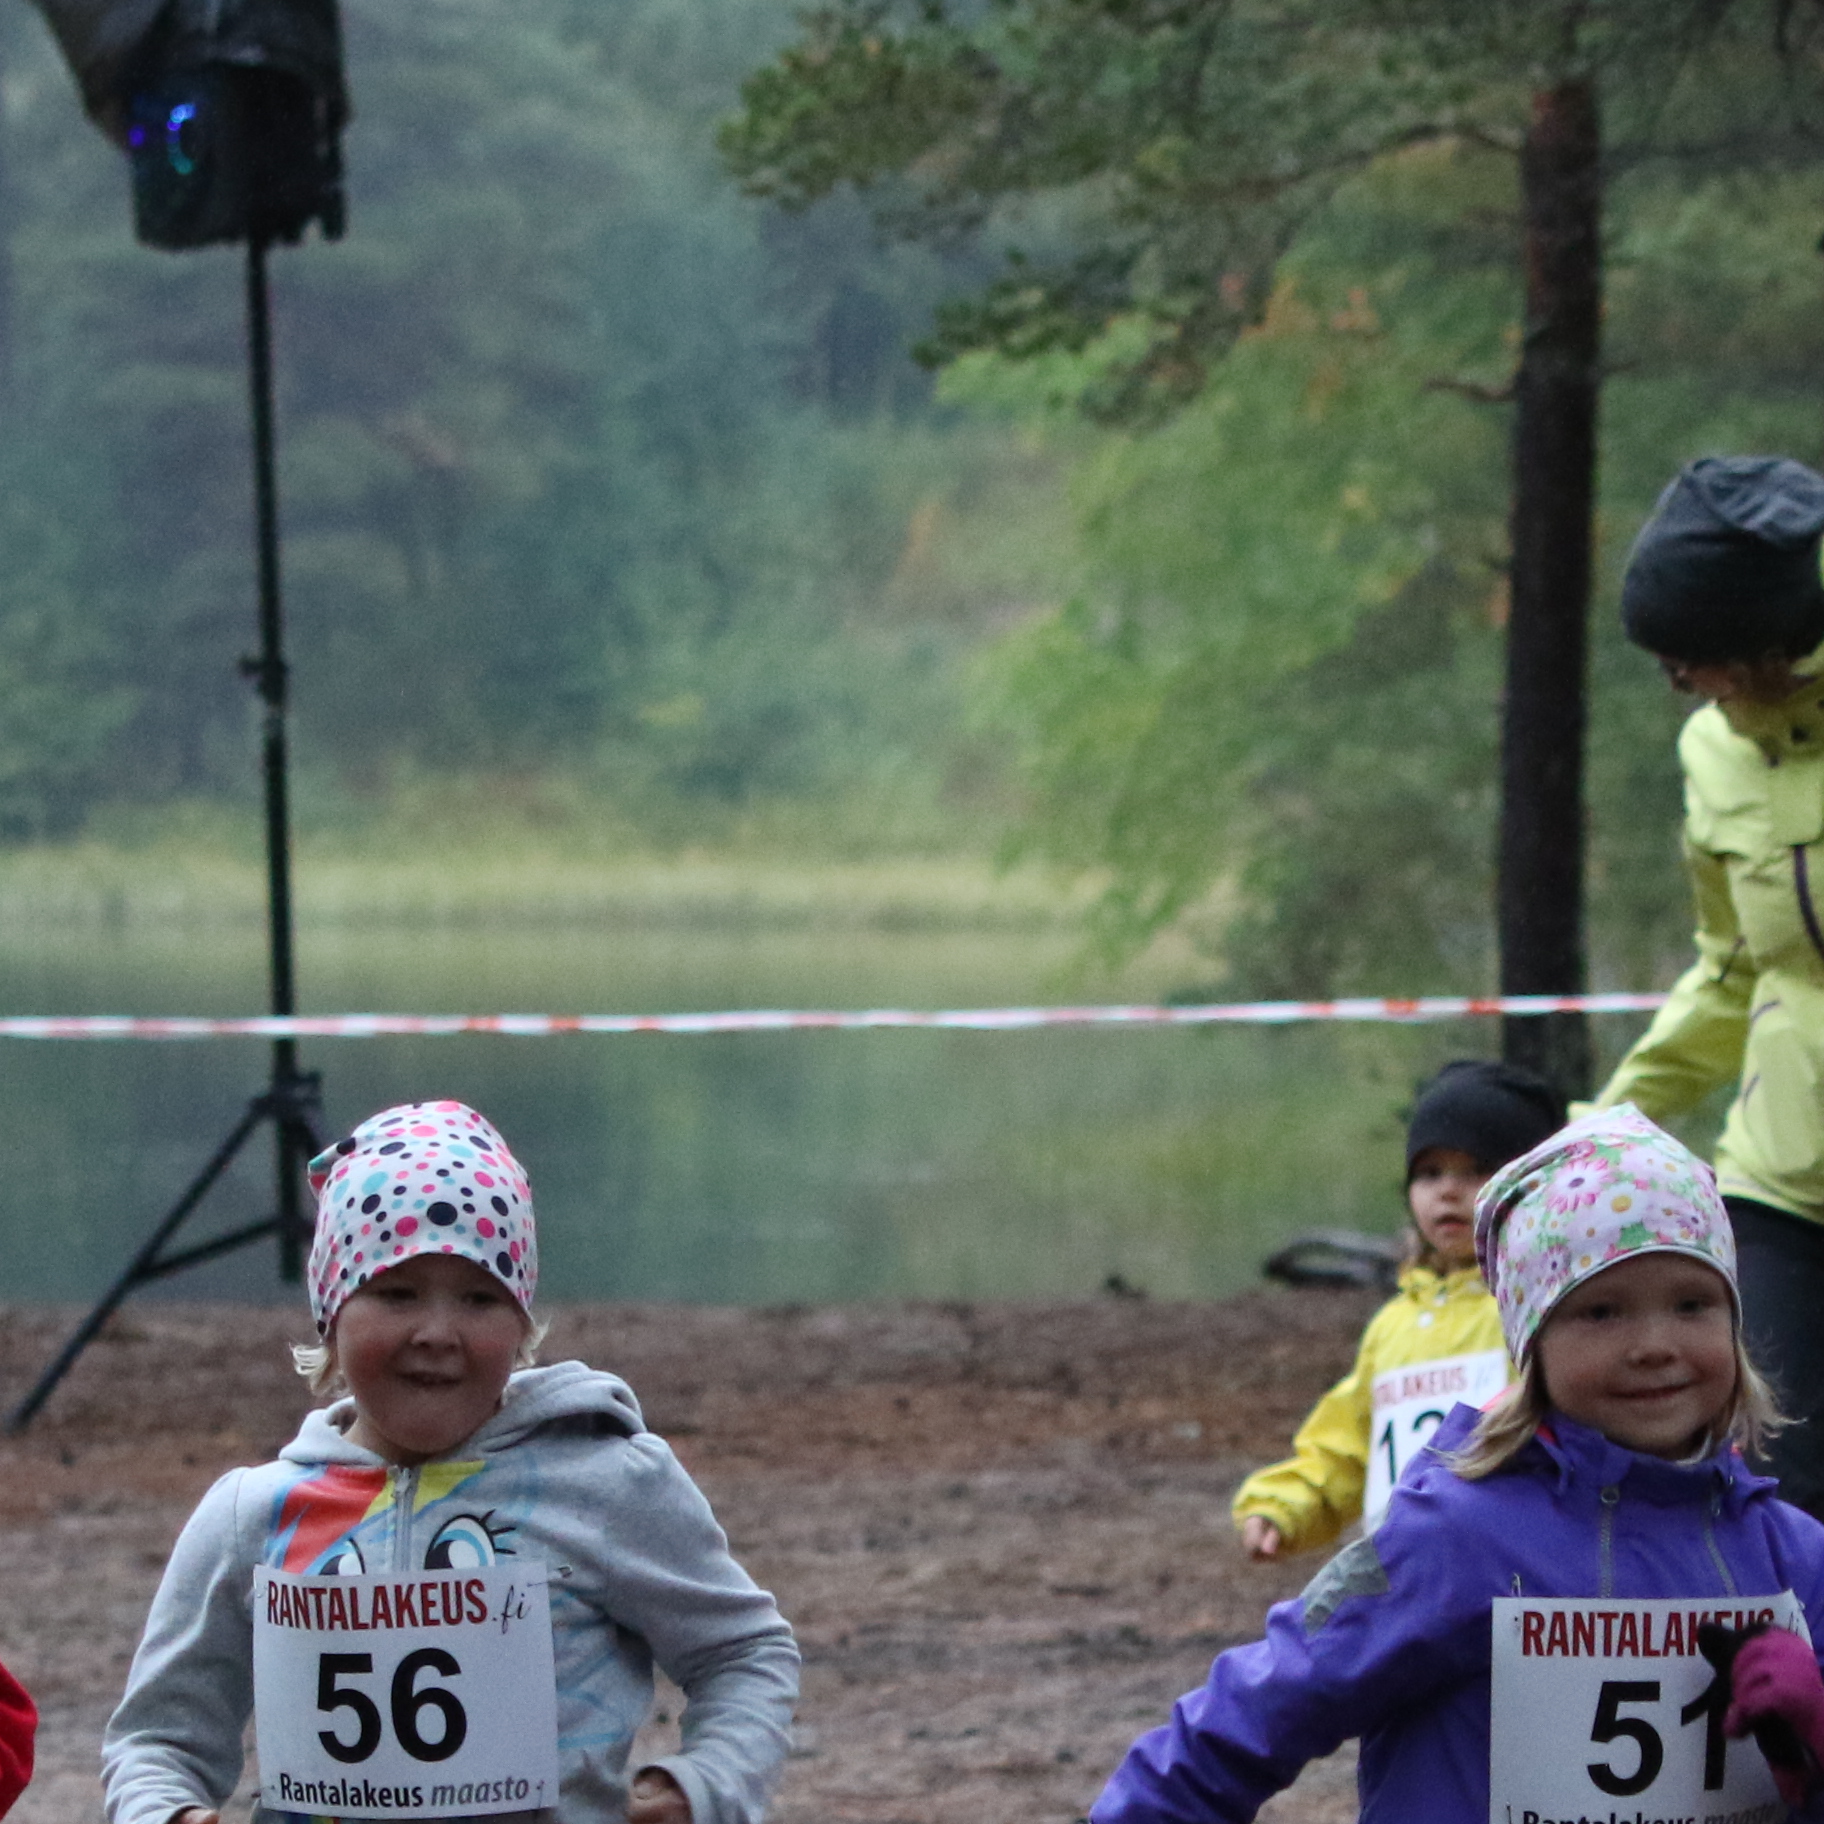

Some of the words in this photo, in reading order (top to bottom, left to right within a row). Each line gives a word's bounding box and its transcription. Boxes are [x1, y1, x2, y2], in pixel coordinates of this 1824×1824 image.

[317, 1647, 467, 1764] 56
[1587, 1681, 1726, 1797] 51
[280, 1773, 423, 1808] Rantalakeus
[431, 1776, 529, 1806] maasto
